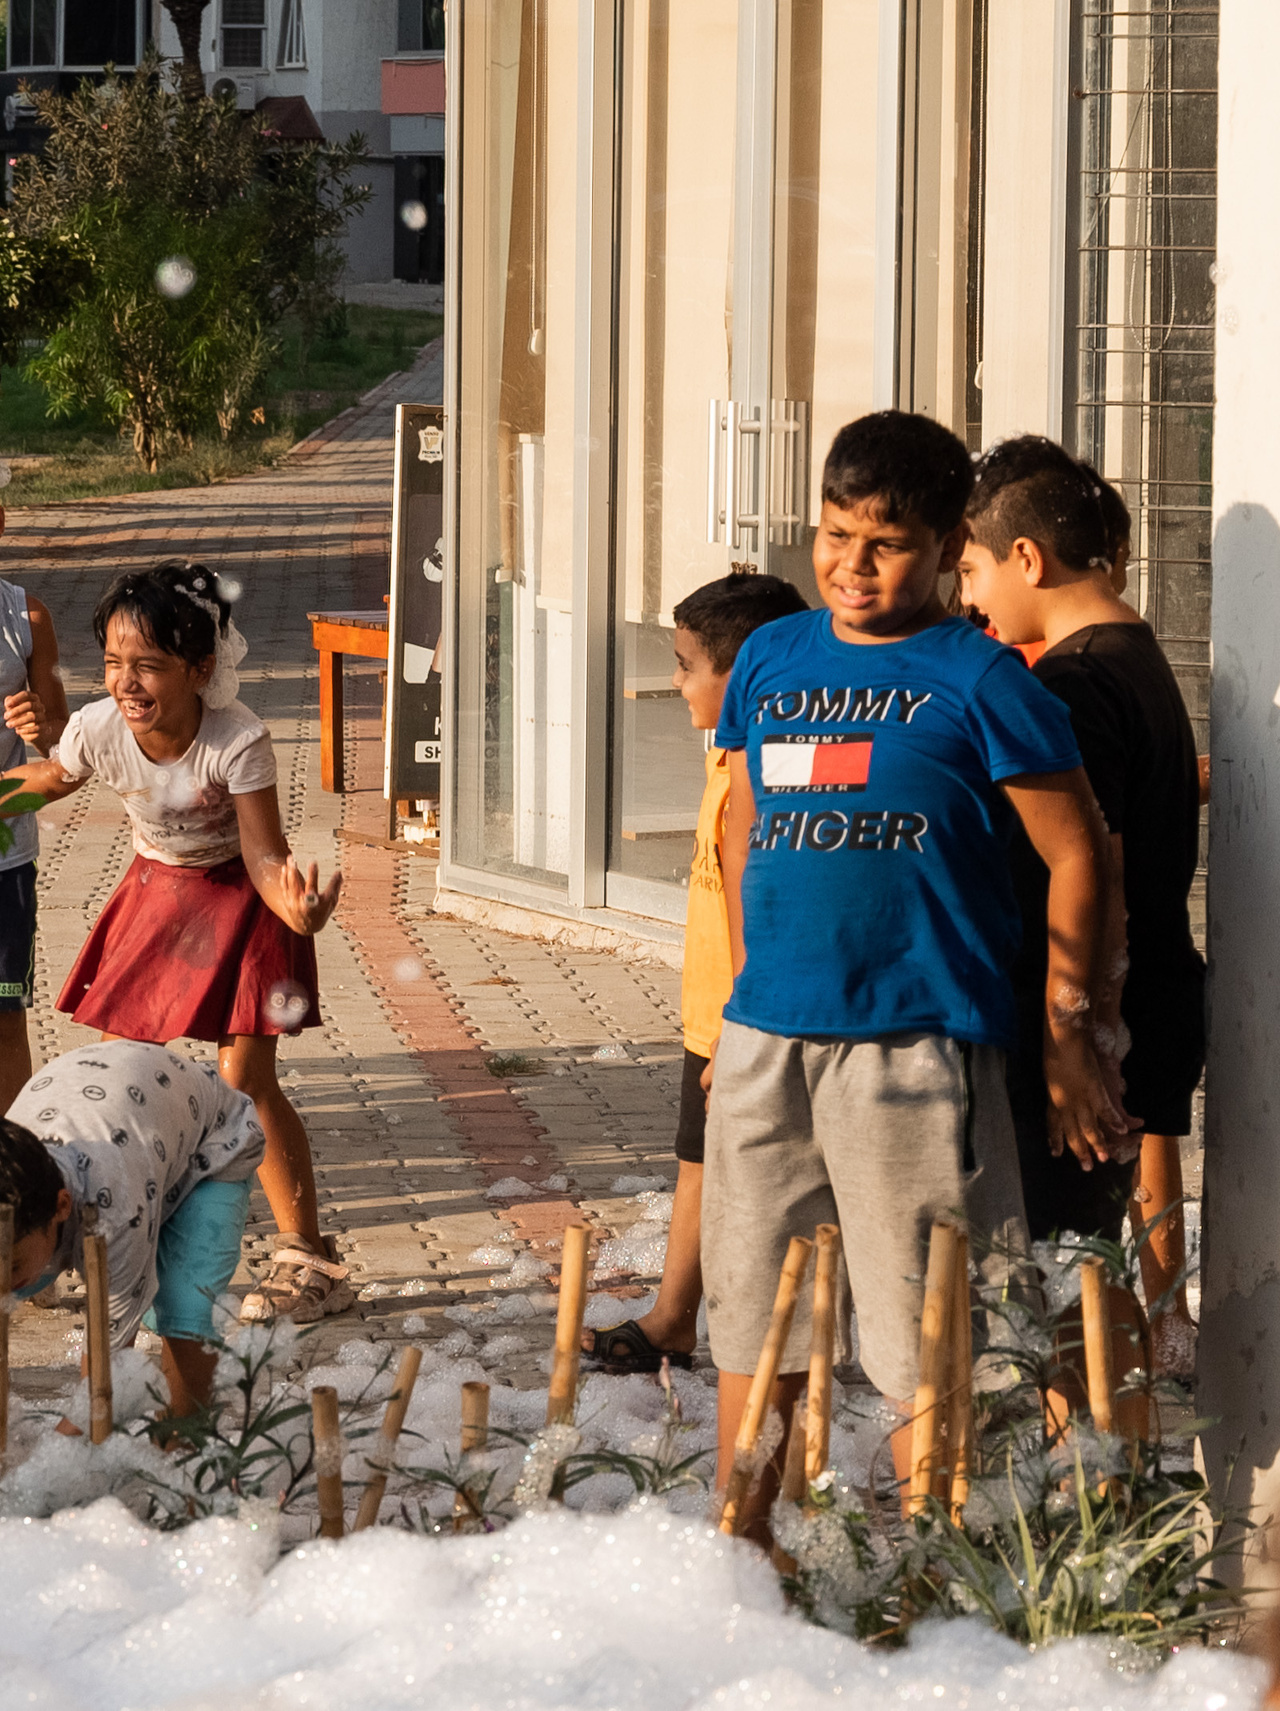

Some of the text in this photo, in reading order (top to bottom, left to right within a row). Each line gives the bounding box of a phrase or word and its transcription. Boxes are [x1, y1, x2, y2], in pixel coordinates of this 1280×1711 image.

[754, 686, 932, 725] TOMMY
[784, 734, 845, 743] TOMMY
[771, 784, 849, 793] HILFIGER
